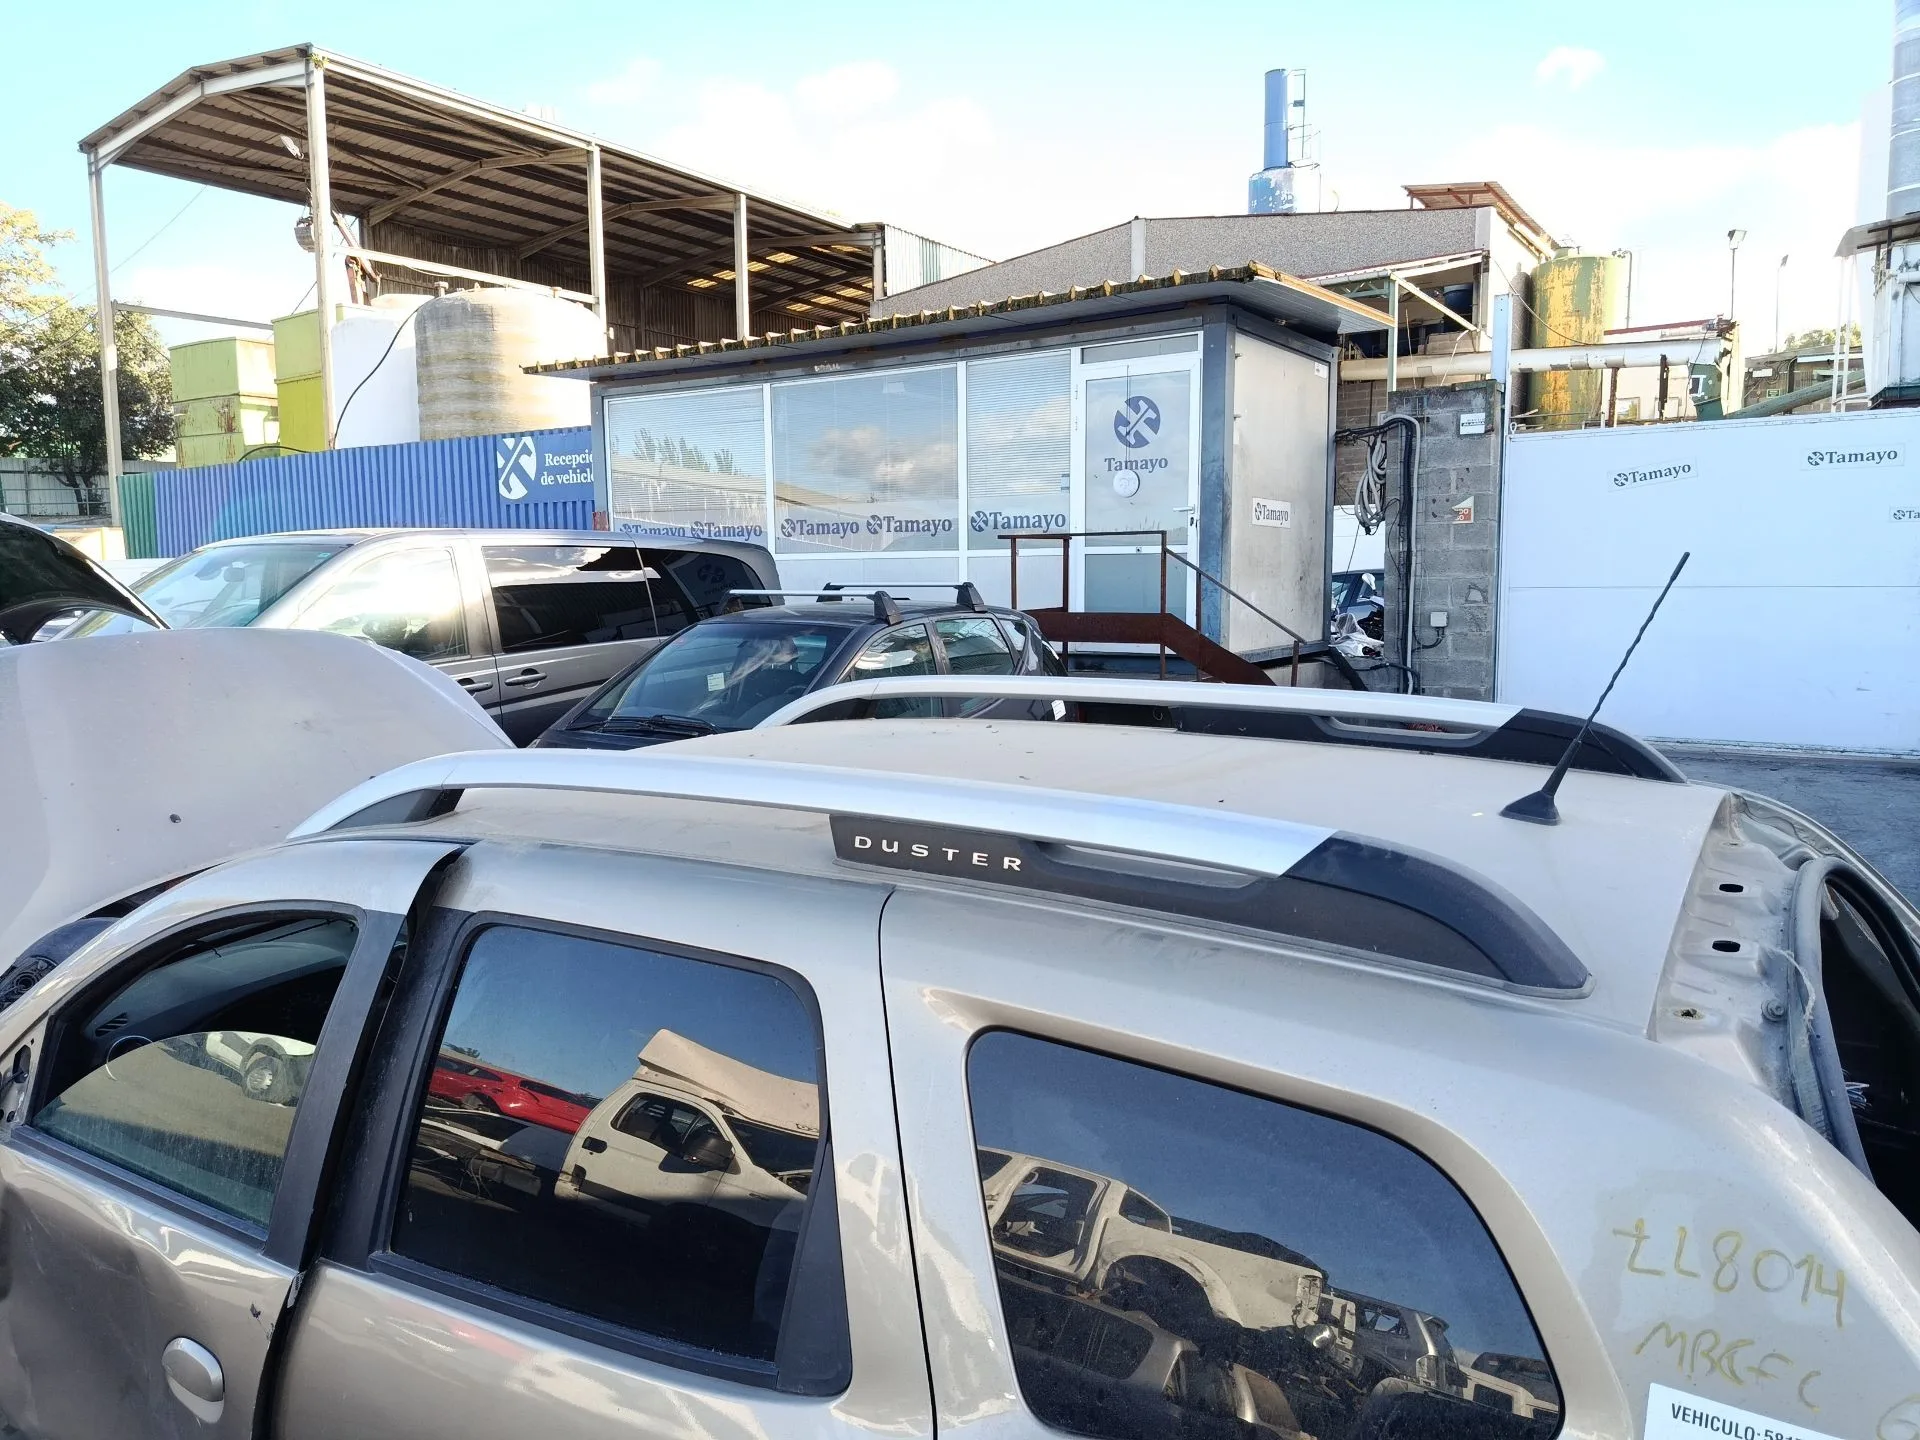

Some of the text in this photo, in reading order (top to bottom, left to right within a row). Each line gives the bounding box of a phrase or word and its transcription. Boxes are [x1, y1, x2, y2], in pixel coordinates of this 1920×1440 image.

[1104, 456, 1168, 473] Tamayo
[1825, 448, 1898, 465] Tamayo
[540, 471, 555, 486] de
[1628, 463, 1691, 484] Tamayo
[989, 510, 1066, 534] Tamayo
[1262, 504, 1289, 526] Tamayo
[704, 522, 763, 541] Tamayo
[796, 515, 952, 539] Tamayo Tamayo
[854, 835, 1022, 872] DUSTER
